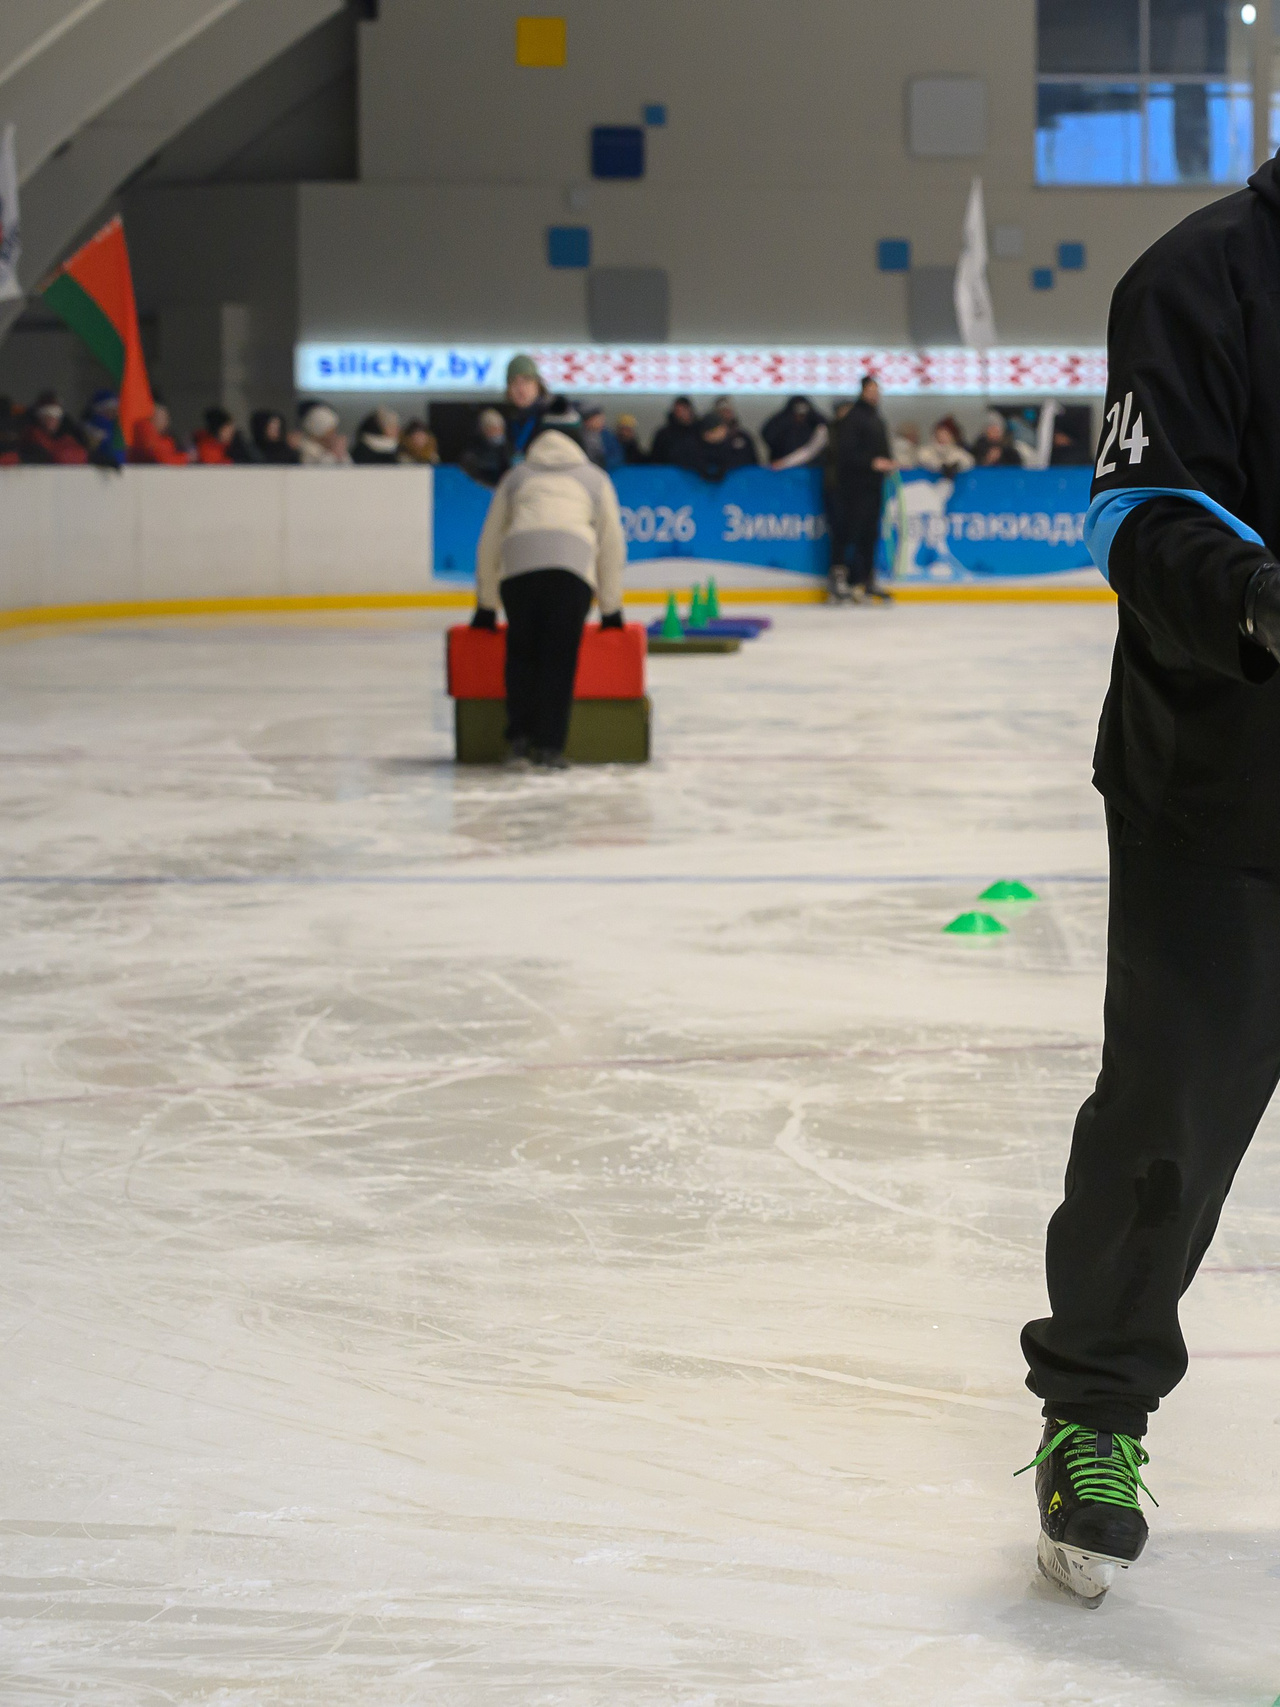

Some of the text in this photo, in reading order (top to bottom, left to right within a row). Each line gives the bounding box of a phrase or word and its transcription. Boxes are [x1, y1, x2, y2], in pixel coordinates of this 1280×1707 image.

[318, 352, 492, 386] silichy.by
[1095, 391, 1149, 479] 24
[721, 503, 828, 543] Зимн
